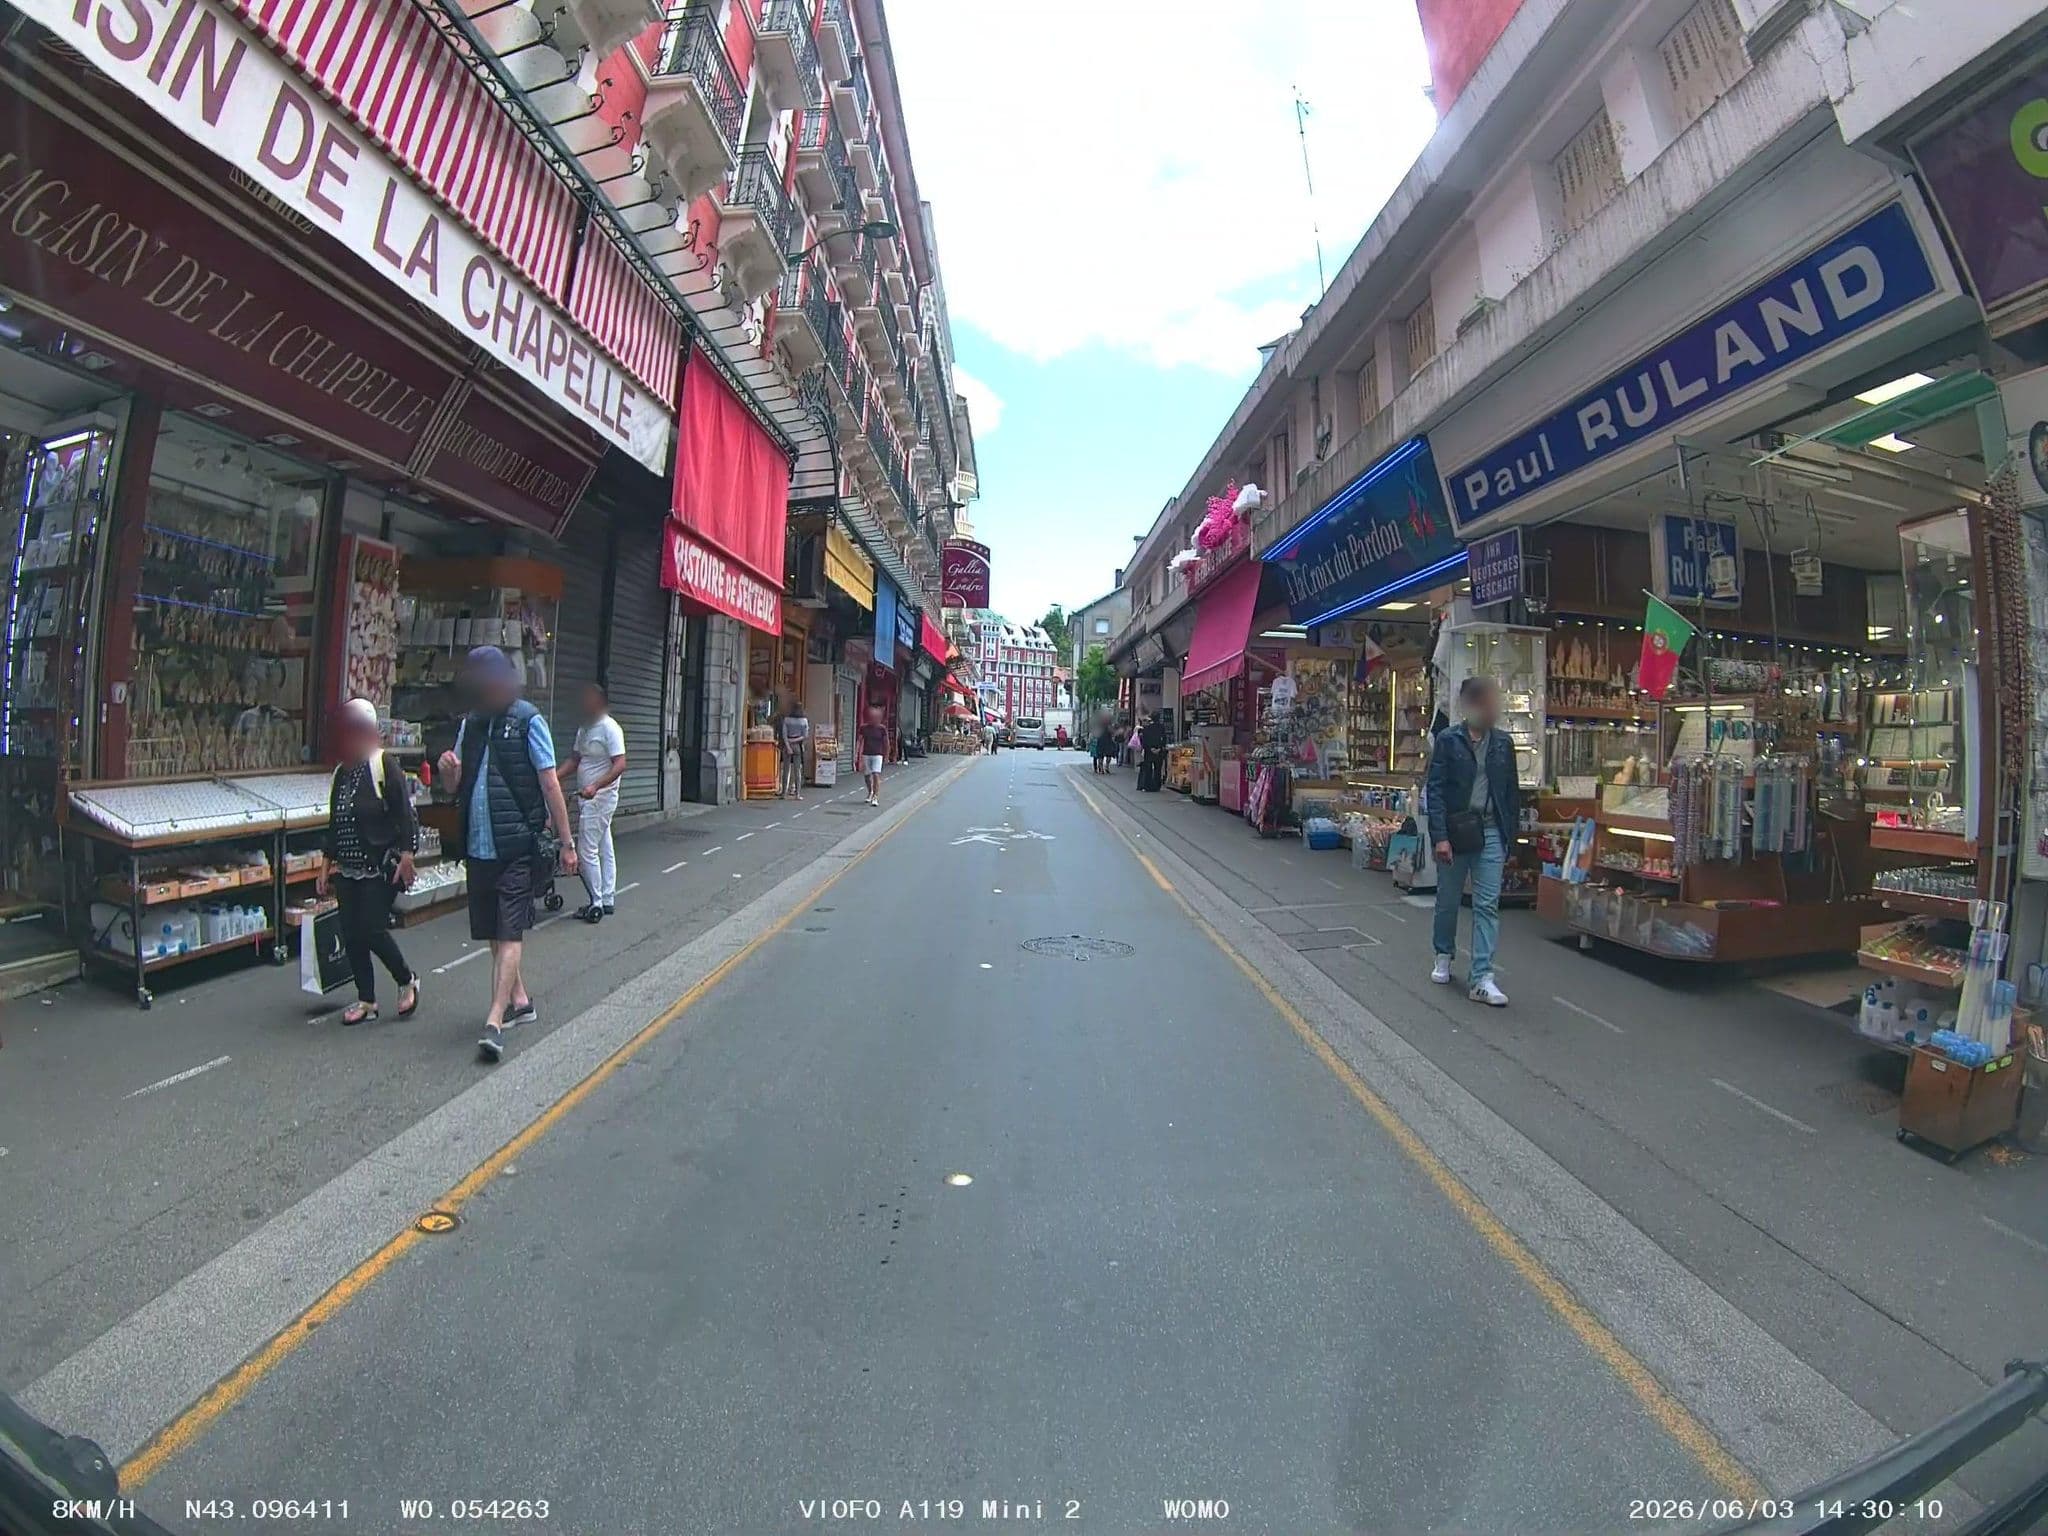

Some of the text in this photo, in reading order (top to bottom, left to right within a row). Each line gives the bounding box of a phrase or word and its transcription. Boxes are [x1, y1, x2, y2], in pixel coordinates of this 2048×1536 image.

[72, 0, 248, 127] SIN
[256, 80, 361, 224] DE
[371, 175, 439, 297] LA
[461, 255, 637, 441] CHAPELLE
[142, 254, 229, 322] DE
[207, 291, 286, 353] LA
[268, 324, 435, 434] CHAPELLE
[1464, 244, 1886, 511] Paul RULAND
[443, 419, 572, 506] RICORDI DI LOURDES
[673, 534, 726, 599] HISTOIRE
[725, 572, 738, 606] DE
[945, 578, 985, 592] Londres
[948, 559, 983, 577] Gallia
[1292, 569, 1307, 601] la
[1301, 553, 1336, 596] Croix
[1333, 541, 1353, 581] du
[1346, 517, 1403, 571] Pardon
[1486, 542, 1501, 559] IHR
